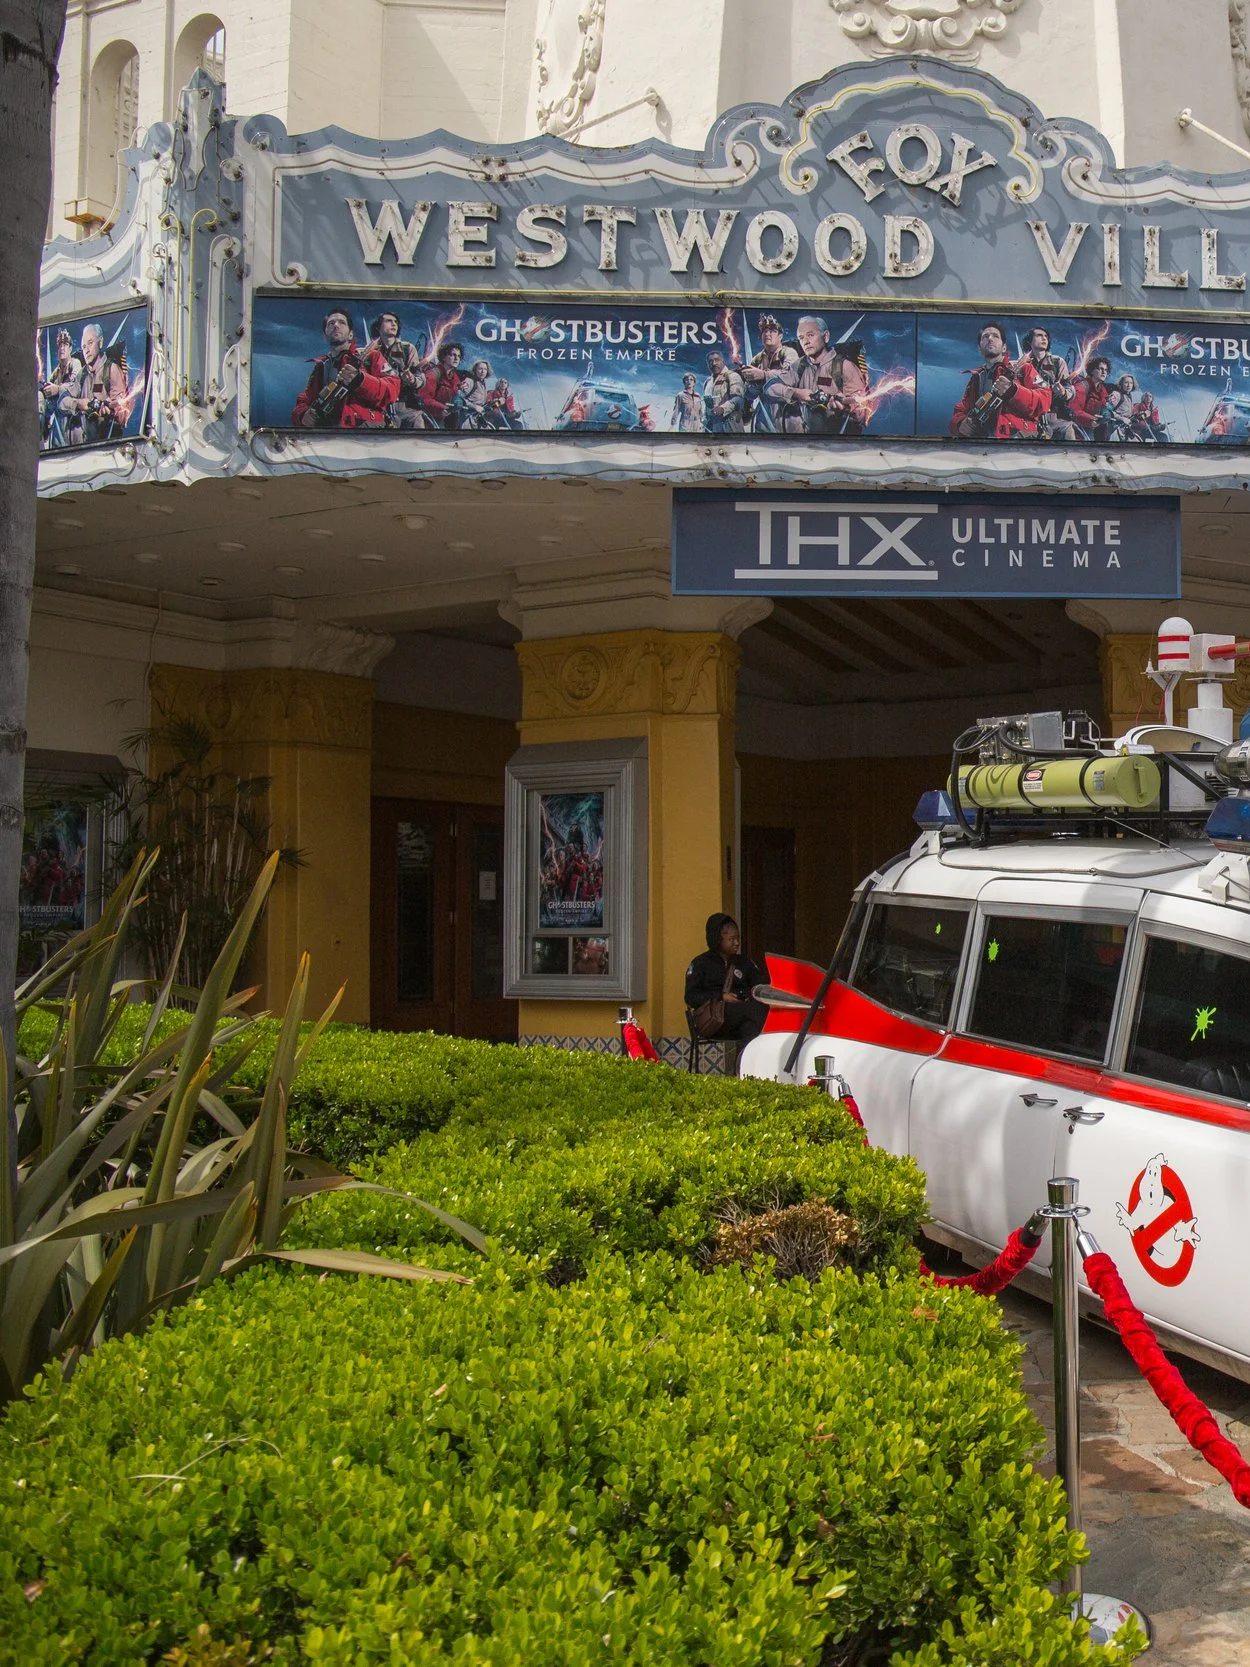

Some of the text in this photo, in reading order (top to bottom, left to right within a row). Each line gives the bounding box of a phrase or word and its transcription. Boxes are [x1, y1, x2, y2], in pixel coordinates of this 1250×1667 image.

[825, 123, 998, 207] FOX
[344, 198, 935, 279] WESTWOOD
[517, 348, 677, 361] FROZEN EMPIRE
[1160, 363, 1231, 376] FROZEN
[735, 502, 1121, 567] THX ULTIMATE
[952, 548, 1121, 569] CINEMA
